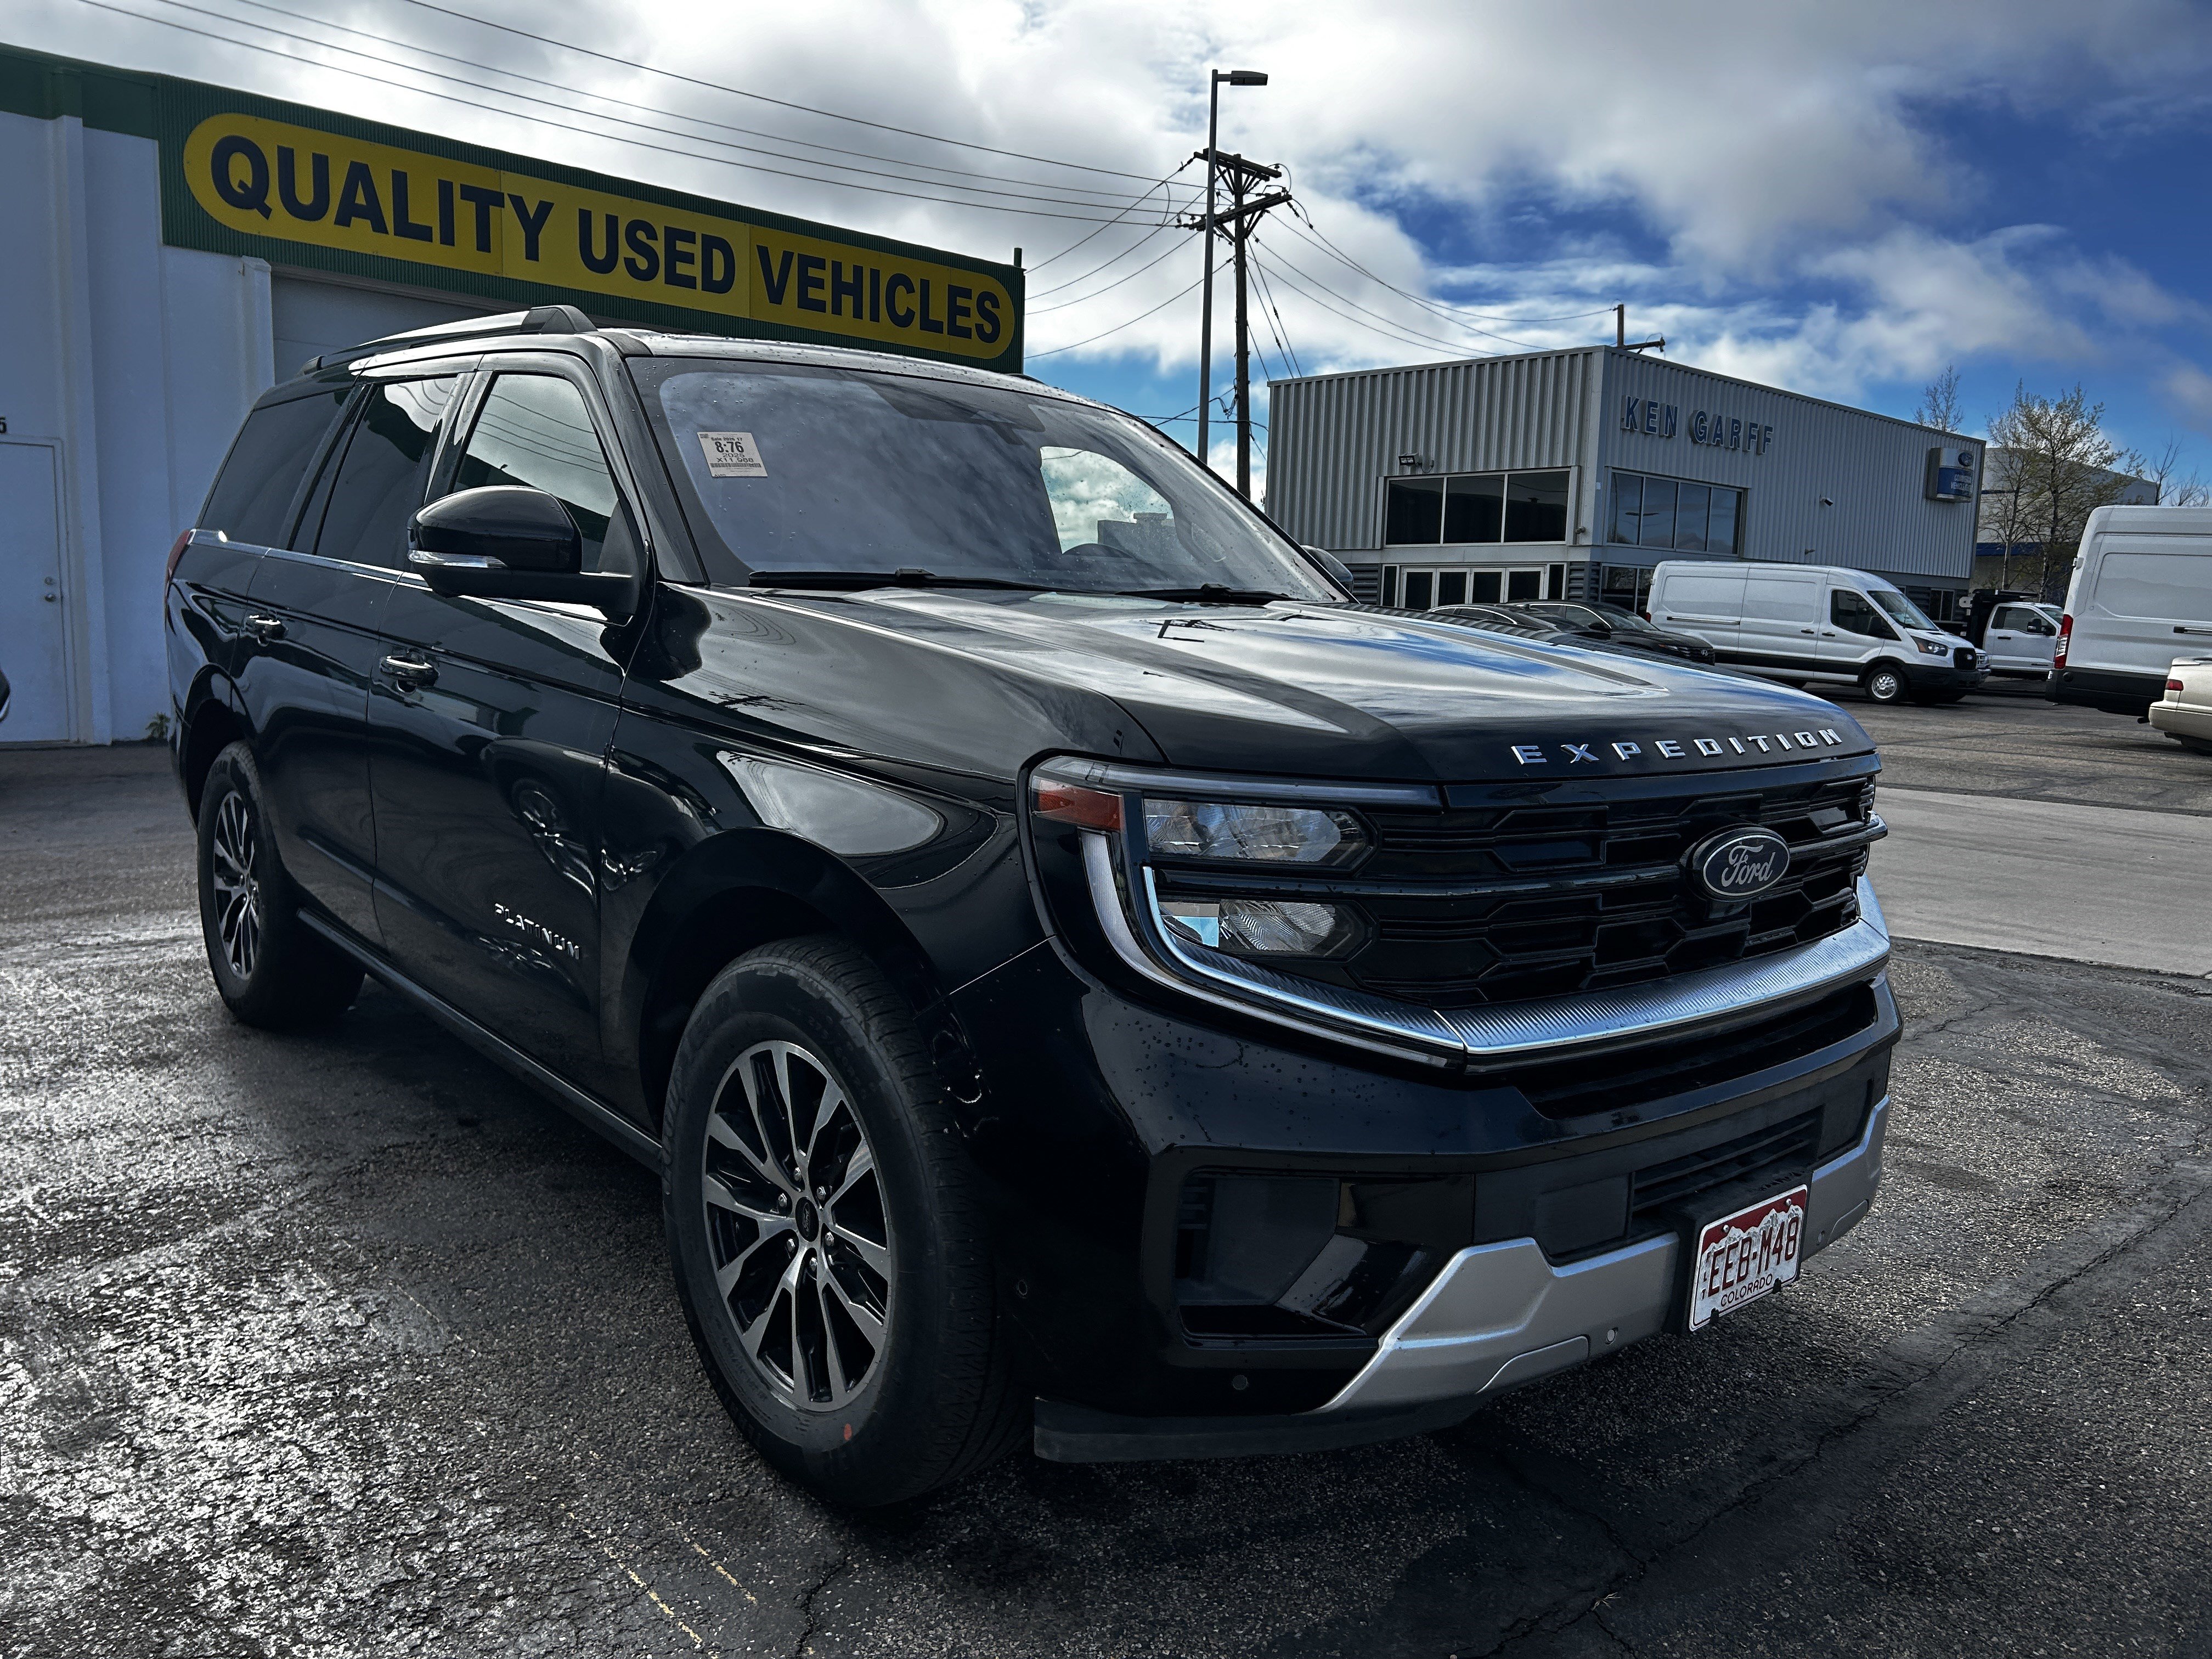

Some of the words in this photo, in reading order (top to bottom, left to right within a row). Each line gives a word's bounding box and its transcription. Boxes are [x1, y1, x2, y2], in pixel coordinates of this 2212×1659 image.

[210, 134, 555, 262] QUALITY
[578, 207, 736, 294] USED
[756, 245, 1001, 344] VEHICLES
[1621, 394, 1678, 437] KEN
[1689, 409, 1774, 455] GARFF
[714, 441, 744, 453] 8:76
[1510, 728, 1843, 765] EXPEDITION
[1721, 844, 1775, 888] Ford
[1720, 1273, 1773, 1307] COLORADO
